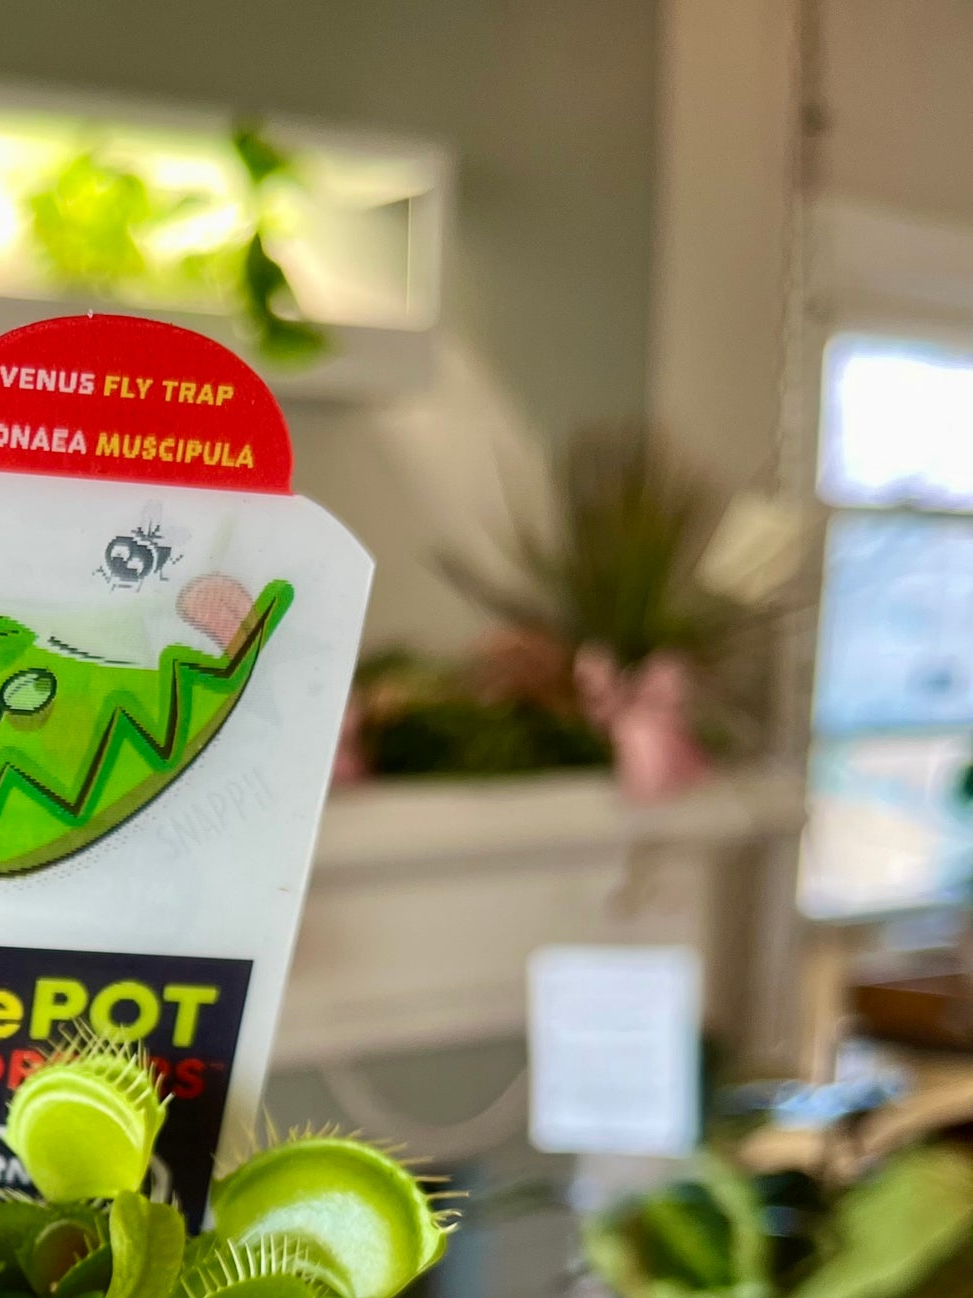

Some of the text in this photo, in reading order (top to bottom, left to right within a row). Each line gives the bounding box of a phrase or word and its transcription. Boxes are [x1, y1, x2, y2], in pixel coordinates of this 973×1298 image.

[0, 365, 235, 406] VENUS FLY TRAP
[95, 432, 256, 469] MUSCIPULA
